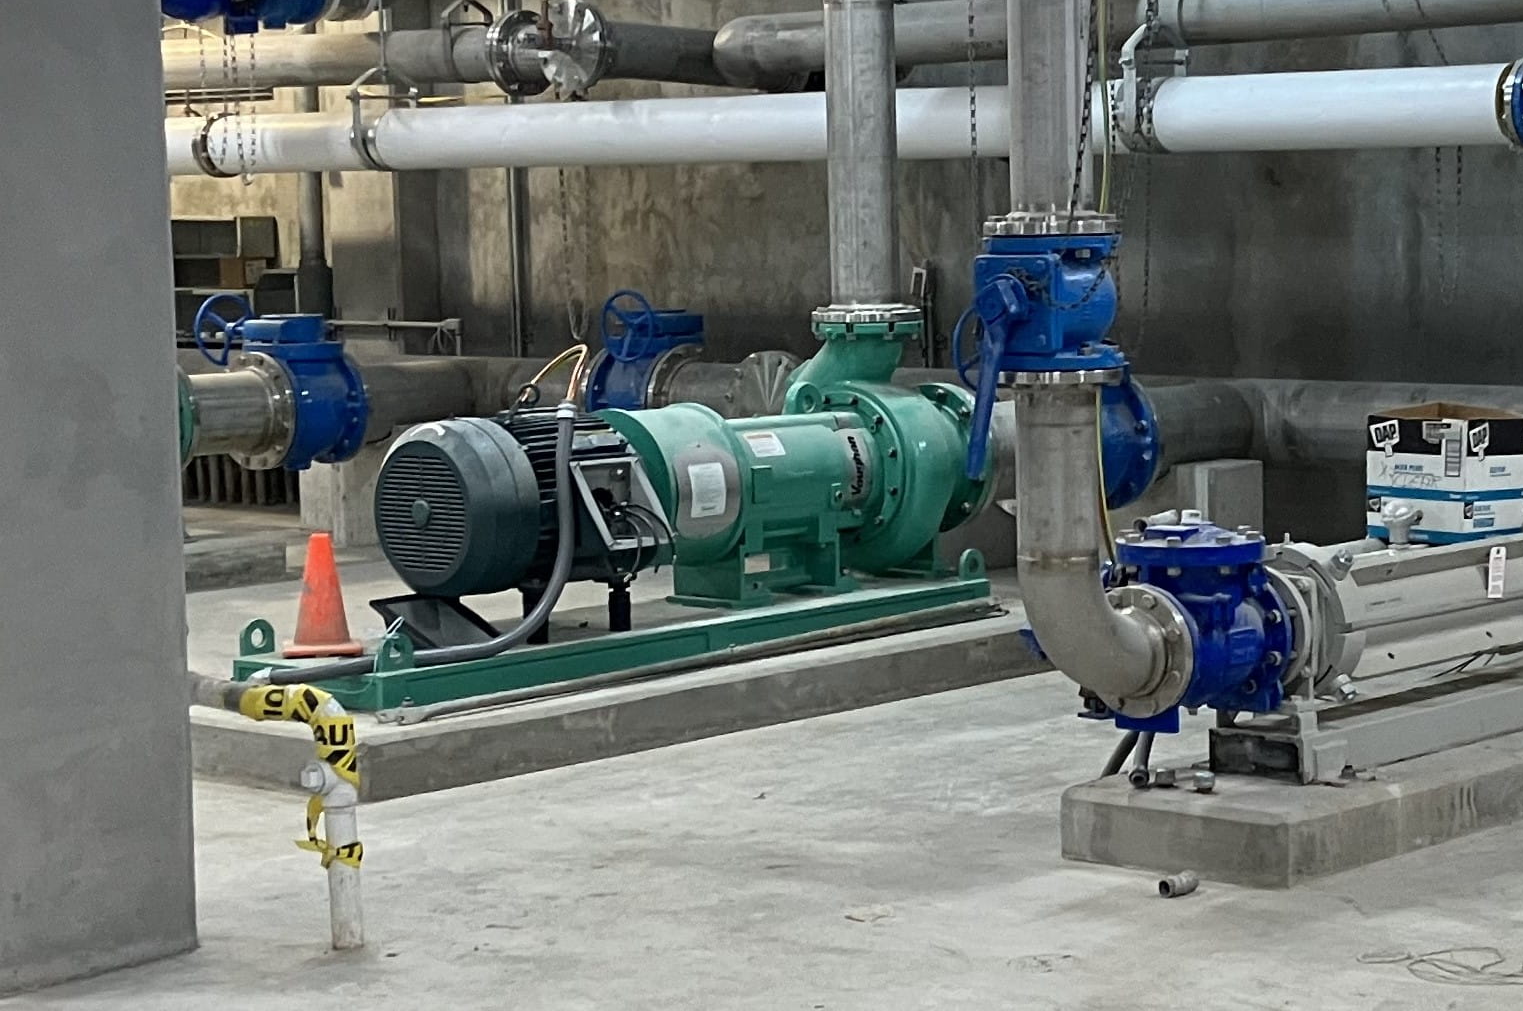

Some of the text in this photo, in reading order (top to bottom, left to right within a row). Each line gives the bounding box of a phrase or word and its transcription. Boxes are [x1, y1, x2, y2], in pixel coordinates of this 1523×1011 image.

[1373, 423, 1398, 444] DAP
[1472, 427, 1488, 448] DAP
[847, 435, 865, 496] Vaughan
